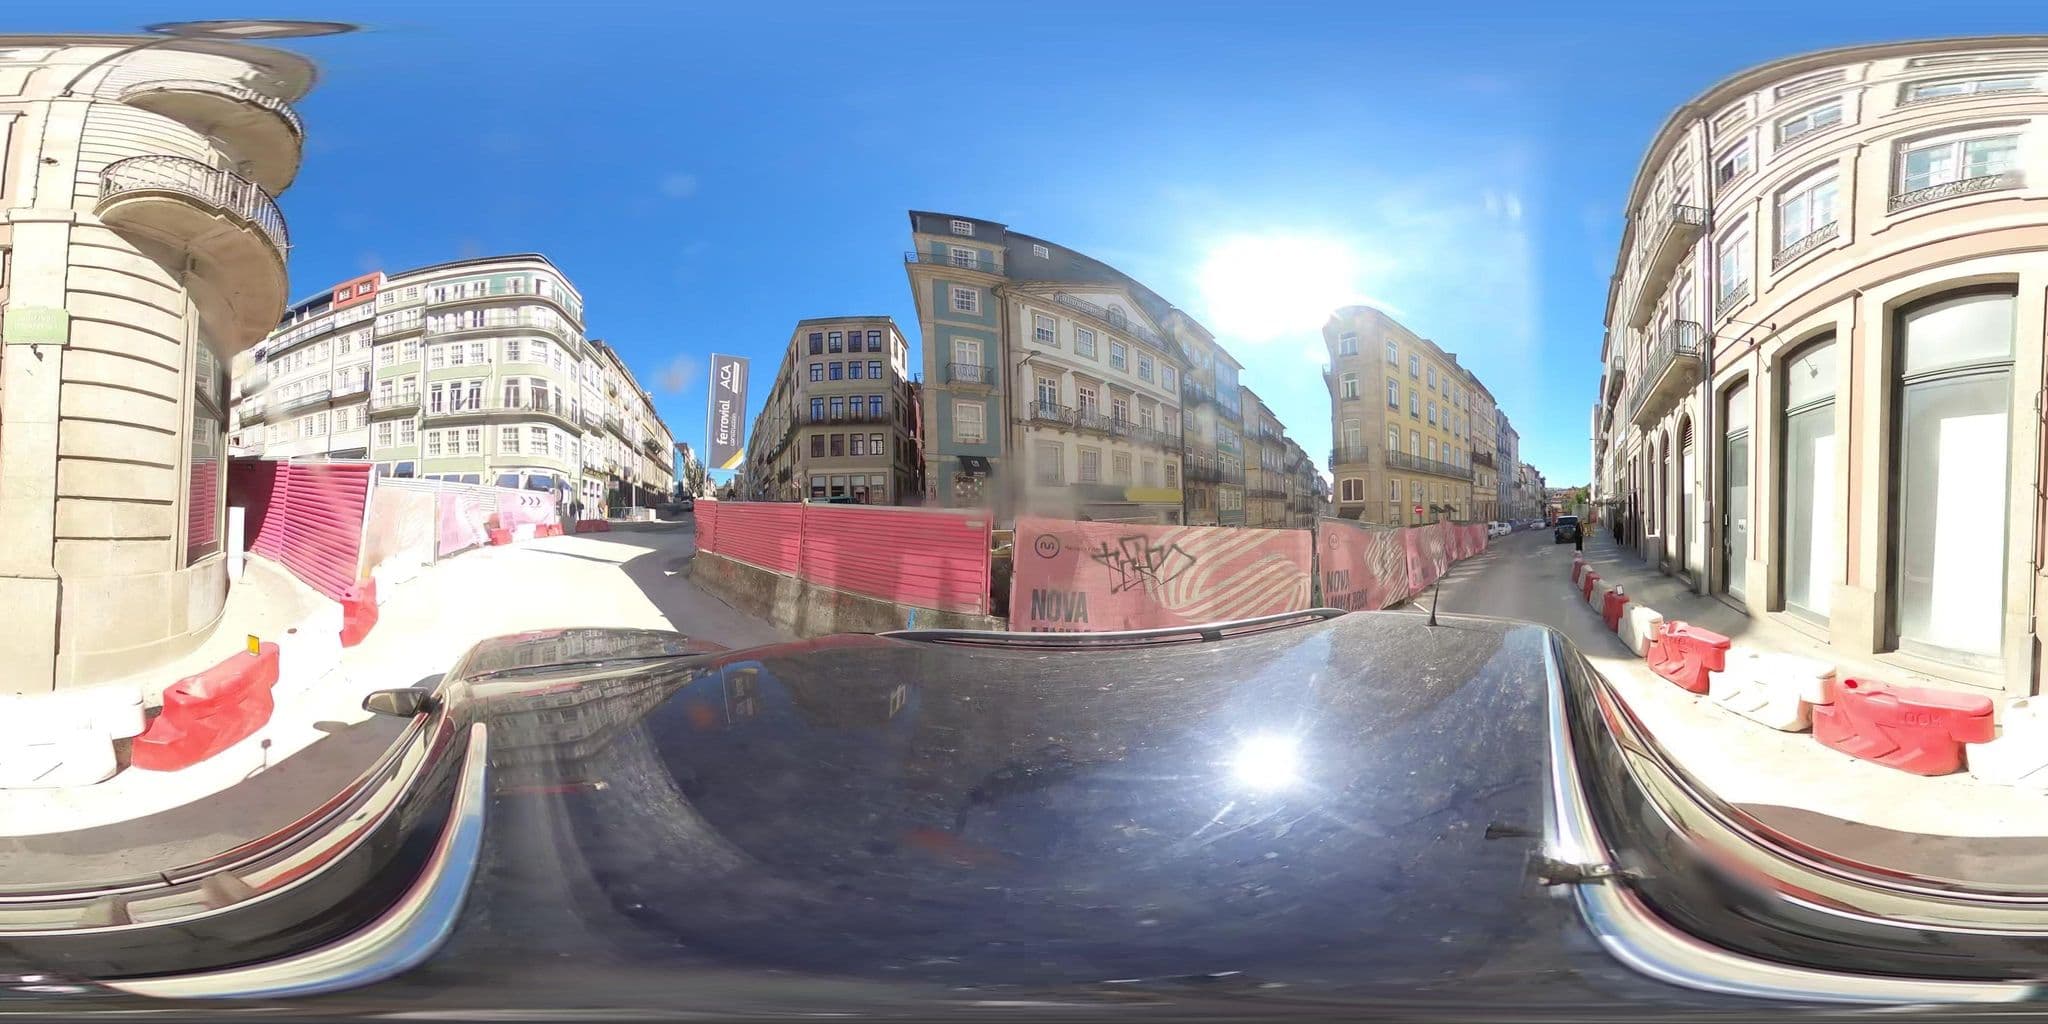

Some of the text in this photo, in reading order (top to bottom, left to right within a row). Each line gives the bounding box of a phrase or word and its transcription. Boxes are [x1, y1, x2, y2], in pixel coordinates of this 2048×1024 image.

[716, 364, 731, 446] ferrovial ACA
[1326, 569, 1350, 593] NOVA
[1031, 588, 1089, 624] NOVA
